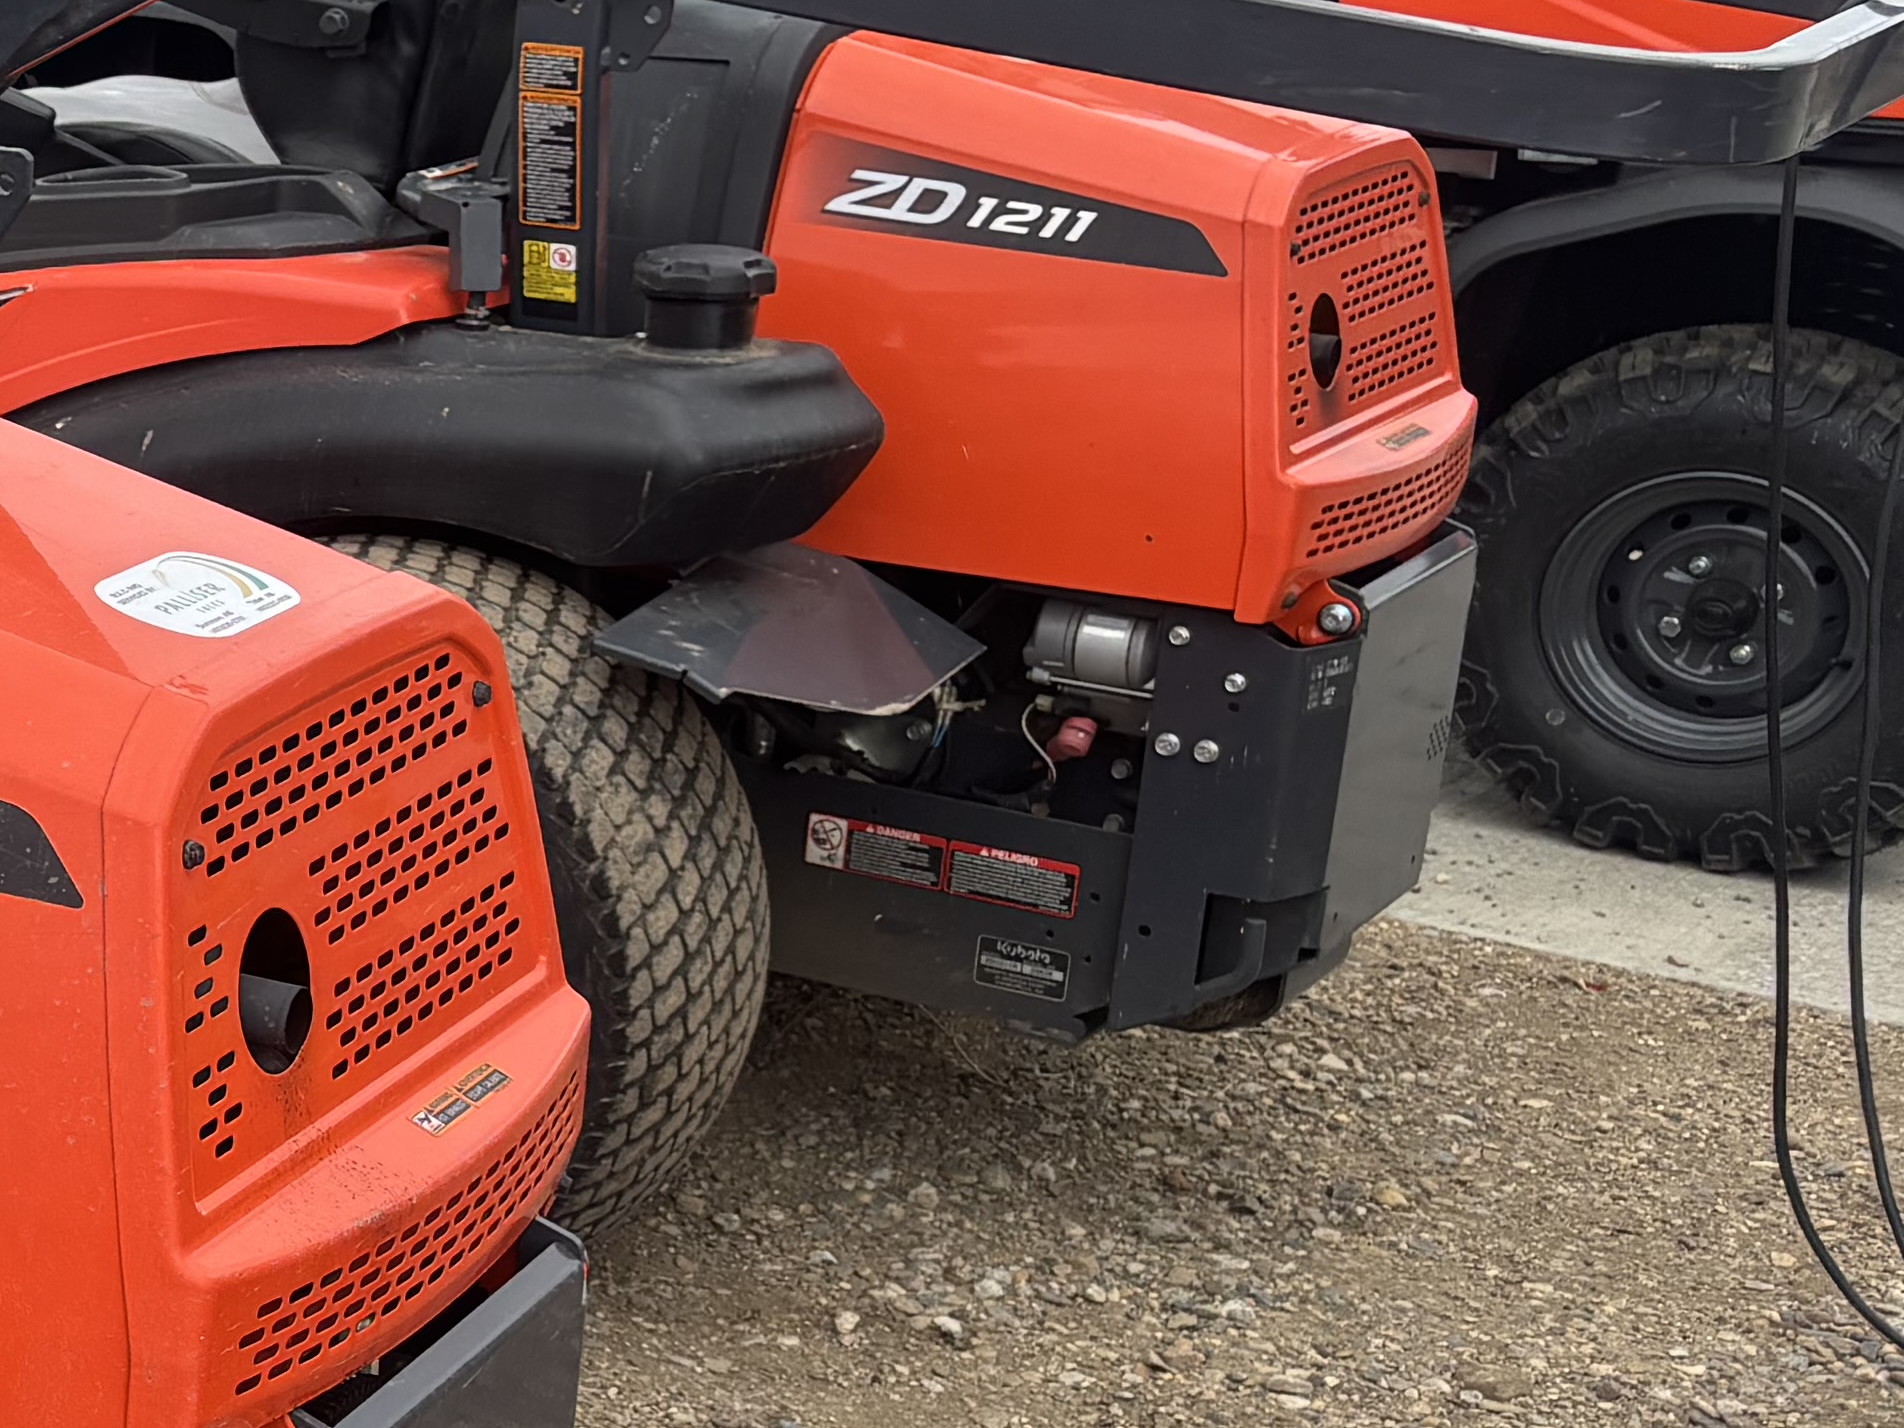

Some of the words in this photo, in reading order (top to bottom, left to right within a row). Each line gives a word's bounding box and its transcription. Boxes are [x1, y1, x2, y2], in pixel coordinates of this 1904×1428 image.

[823, 169, 967, 225] ZD
[966, 196, 1098, 243] 1211
[153, 582, 228, 615] PALLISER
